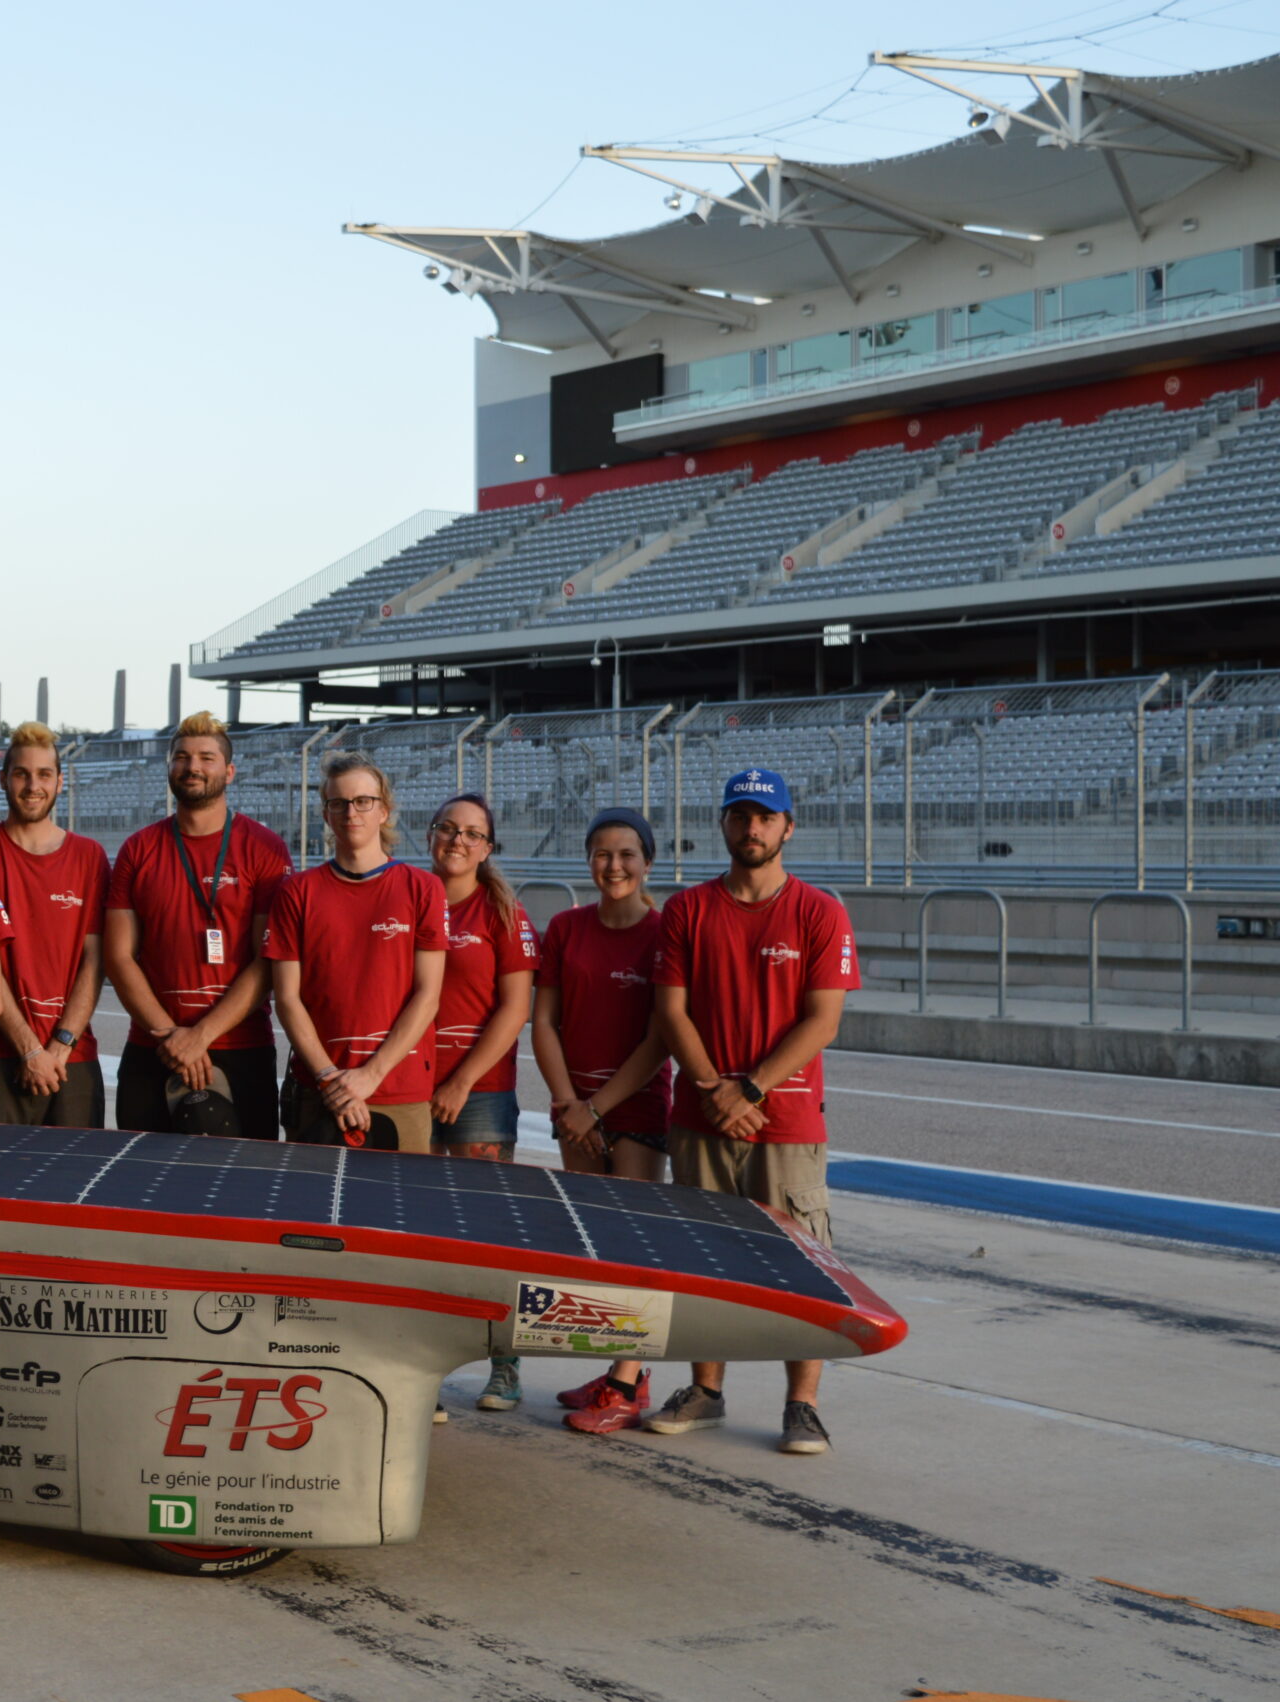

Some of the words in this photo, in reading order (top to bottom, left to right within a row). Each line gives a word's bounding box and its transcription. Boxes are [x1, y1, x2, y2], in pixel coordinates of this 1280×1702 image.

[523, 942, 536, 957] 92
[840, 957, 851, 975] 92
[218, 1294, 255, 1307] CAD
[0, 1297, 53, 1330] S&G
[64, 1300, 168, 1334] MATHIEU
[528, 1321, 576, 1332] American
[574, 1325, 600, 1334] Solar
[600, 1327, 649, 1338] Challenge
[268, 1342, 341, 1353] Panasonic
[0, 1361, 61, 1387] cfp
[163, 1368, 323, 1458] ÉTS
[141, 1469, 160, 1485] Le
[166, 1471, 211, 1489] génie
[217, 1475, 256, 1491] pour
[151, 1500, 193, 1529] TD
[215, 1501, 275, 1513] Fondation
[279, 1503, 294, 1513] TD
[215, 1513, 235, 1524] des
[238, 1514, 267, 1525] amis
[270, 1516, 284, 1525] de
[215, 1526, 313, 1539] l'environnement
